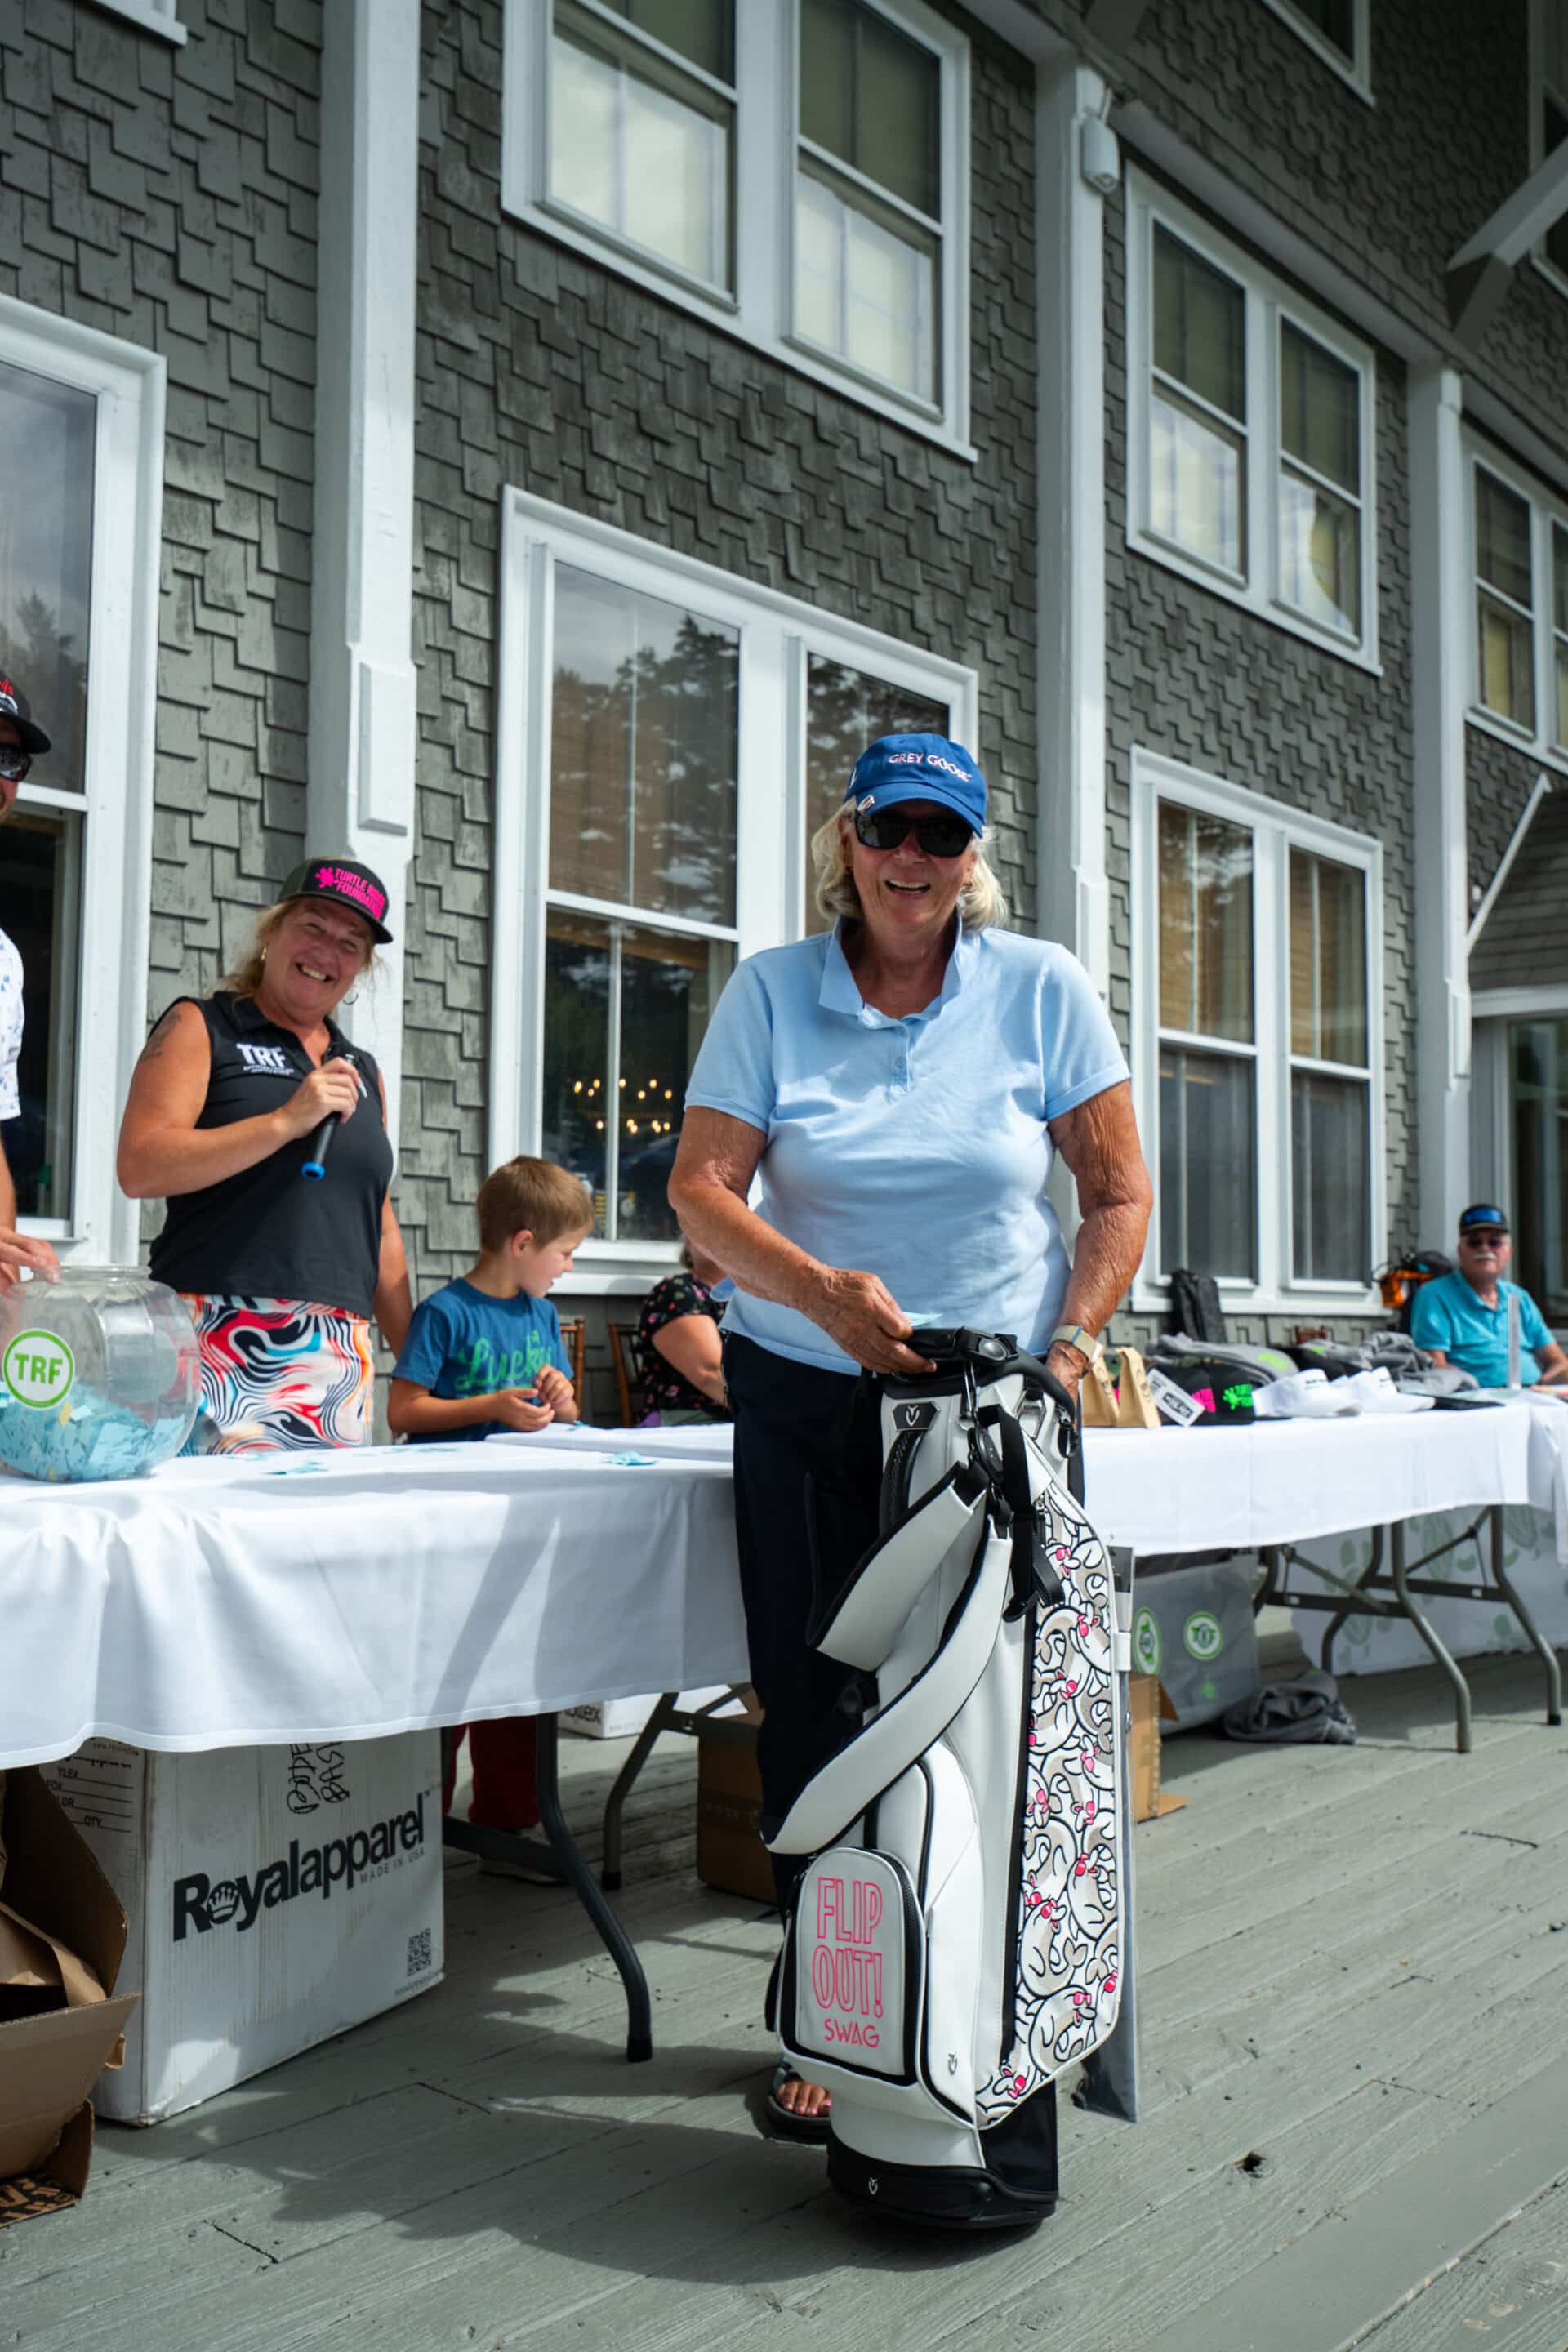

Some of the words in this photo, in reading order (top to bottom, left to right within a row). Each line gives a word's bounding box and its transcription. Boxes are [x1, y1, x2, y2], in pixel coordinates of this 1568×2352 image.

[889, 753, 924, 764] GREY
[335, 868, 367, 892] TURTLE
[236, 1042, 285, 1068] TRF
[14, 1352, 64, 1386] TRF
[359, 1862, 391, 1884] MADE
[817, 1877, 883, 1944] FLIP
[812, 1944, 884, 2019] OUT!
[824, 2017, 880, 2048] SWAG
